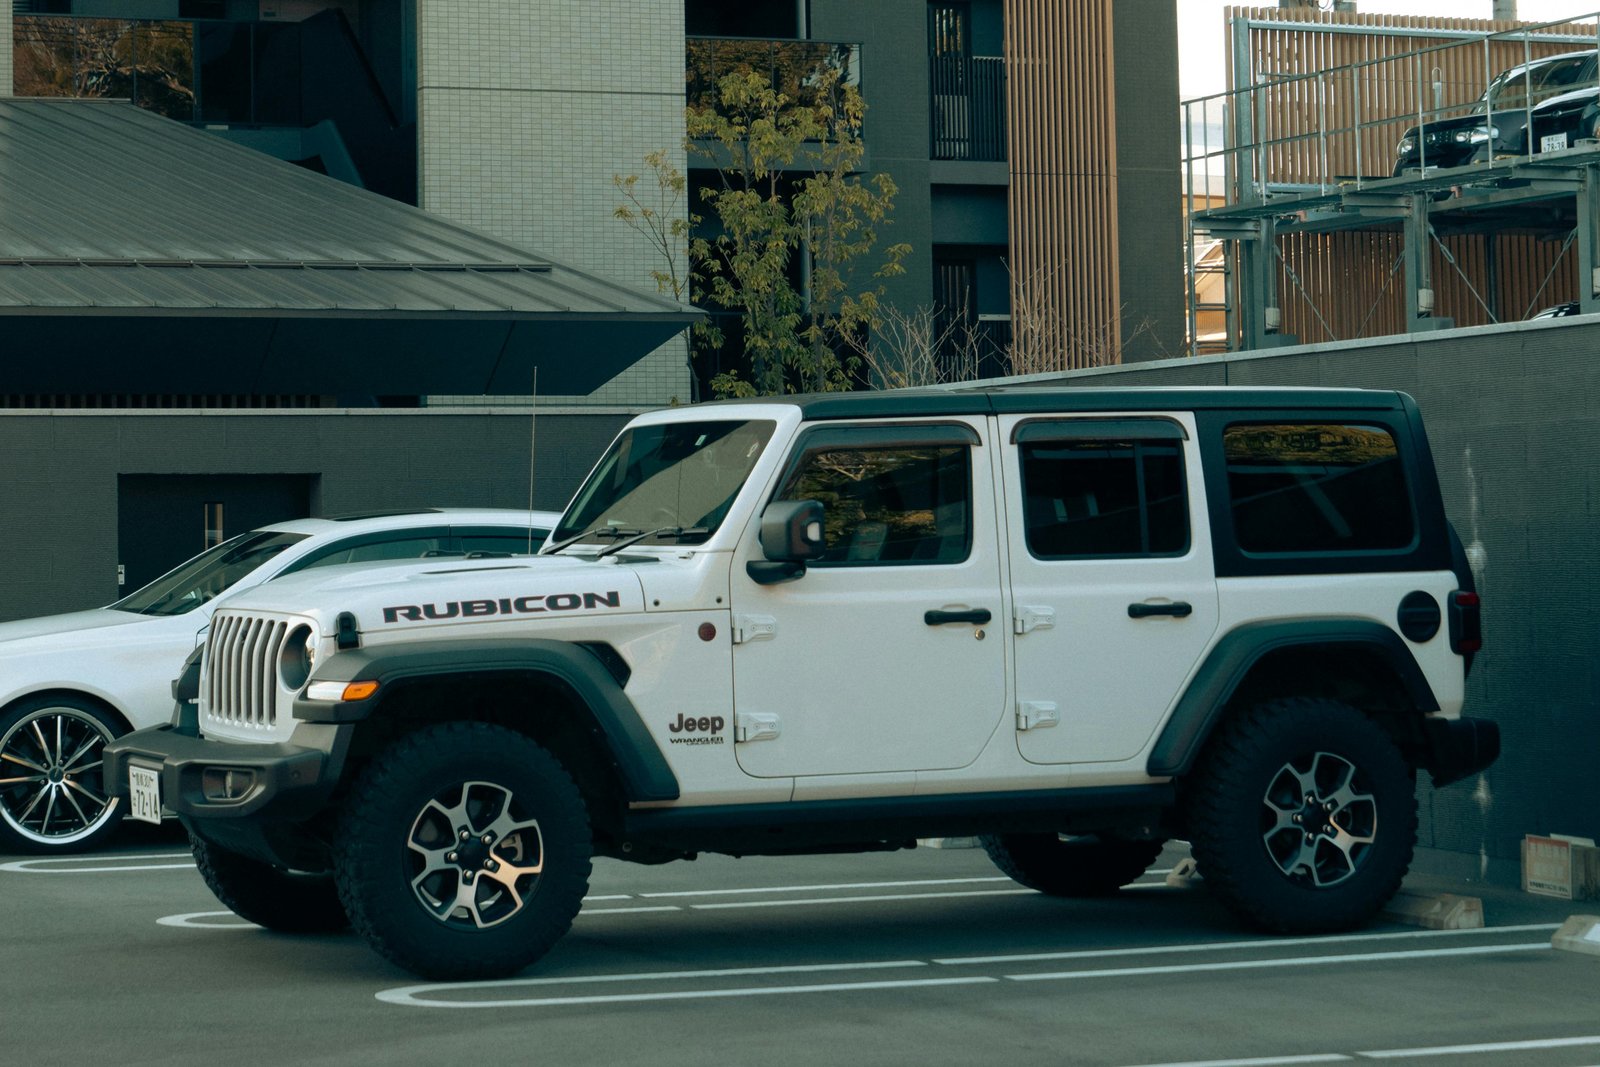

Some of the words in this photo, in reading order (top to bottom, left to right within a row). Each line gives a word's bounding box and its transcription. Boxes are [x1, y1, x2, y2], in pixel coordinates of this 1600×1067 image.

[382, 591, 621, 623] RUBICON
[669, 712, 725, 735] Jeep
[669, 736, 724, 744] WRANGLER
[136, 789, 159, 821] 72-14
